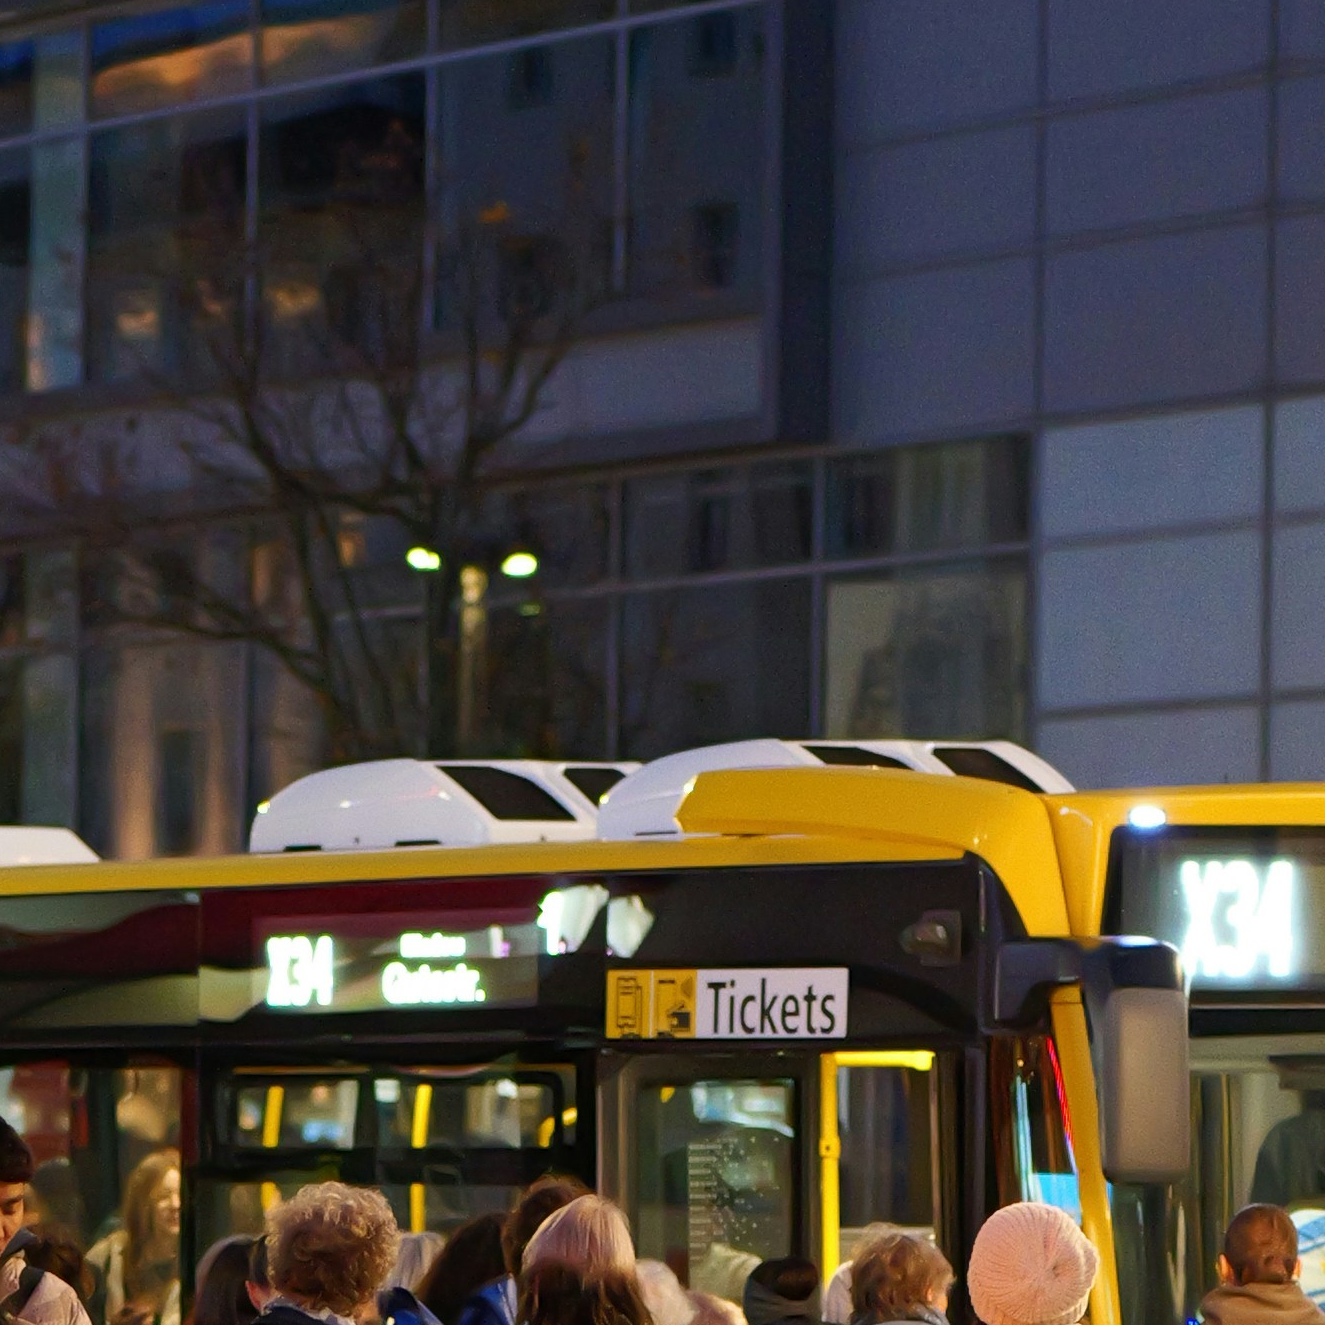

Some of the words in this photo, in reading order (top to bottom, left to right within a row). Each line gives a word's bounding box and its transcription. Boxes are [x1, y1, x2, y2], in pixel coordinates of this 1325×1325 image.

[1179, 859, 1294, 978] X34
[266, 934, 334, 1007] X34
[707, 977, 836, 1035] Tickets
